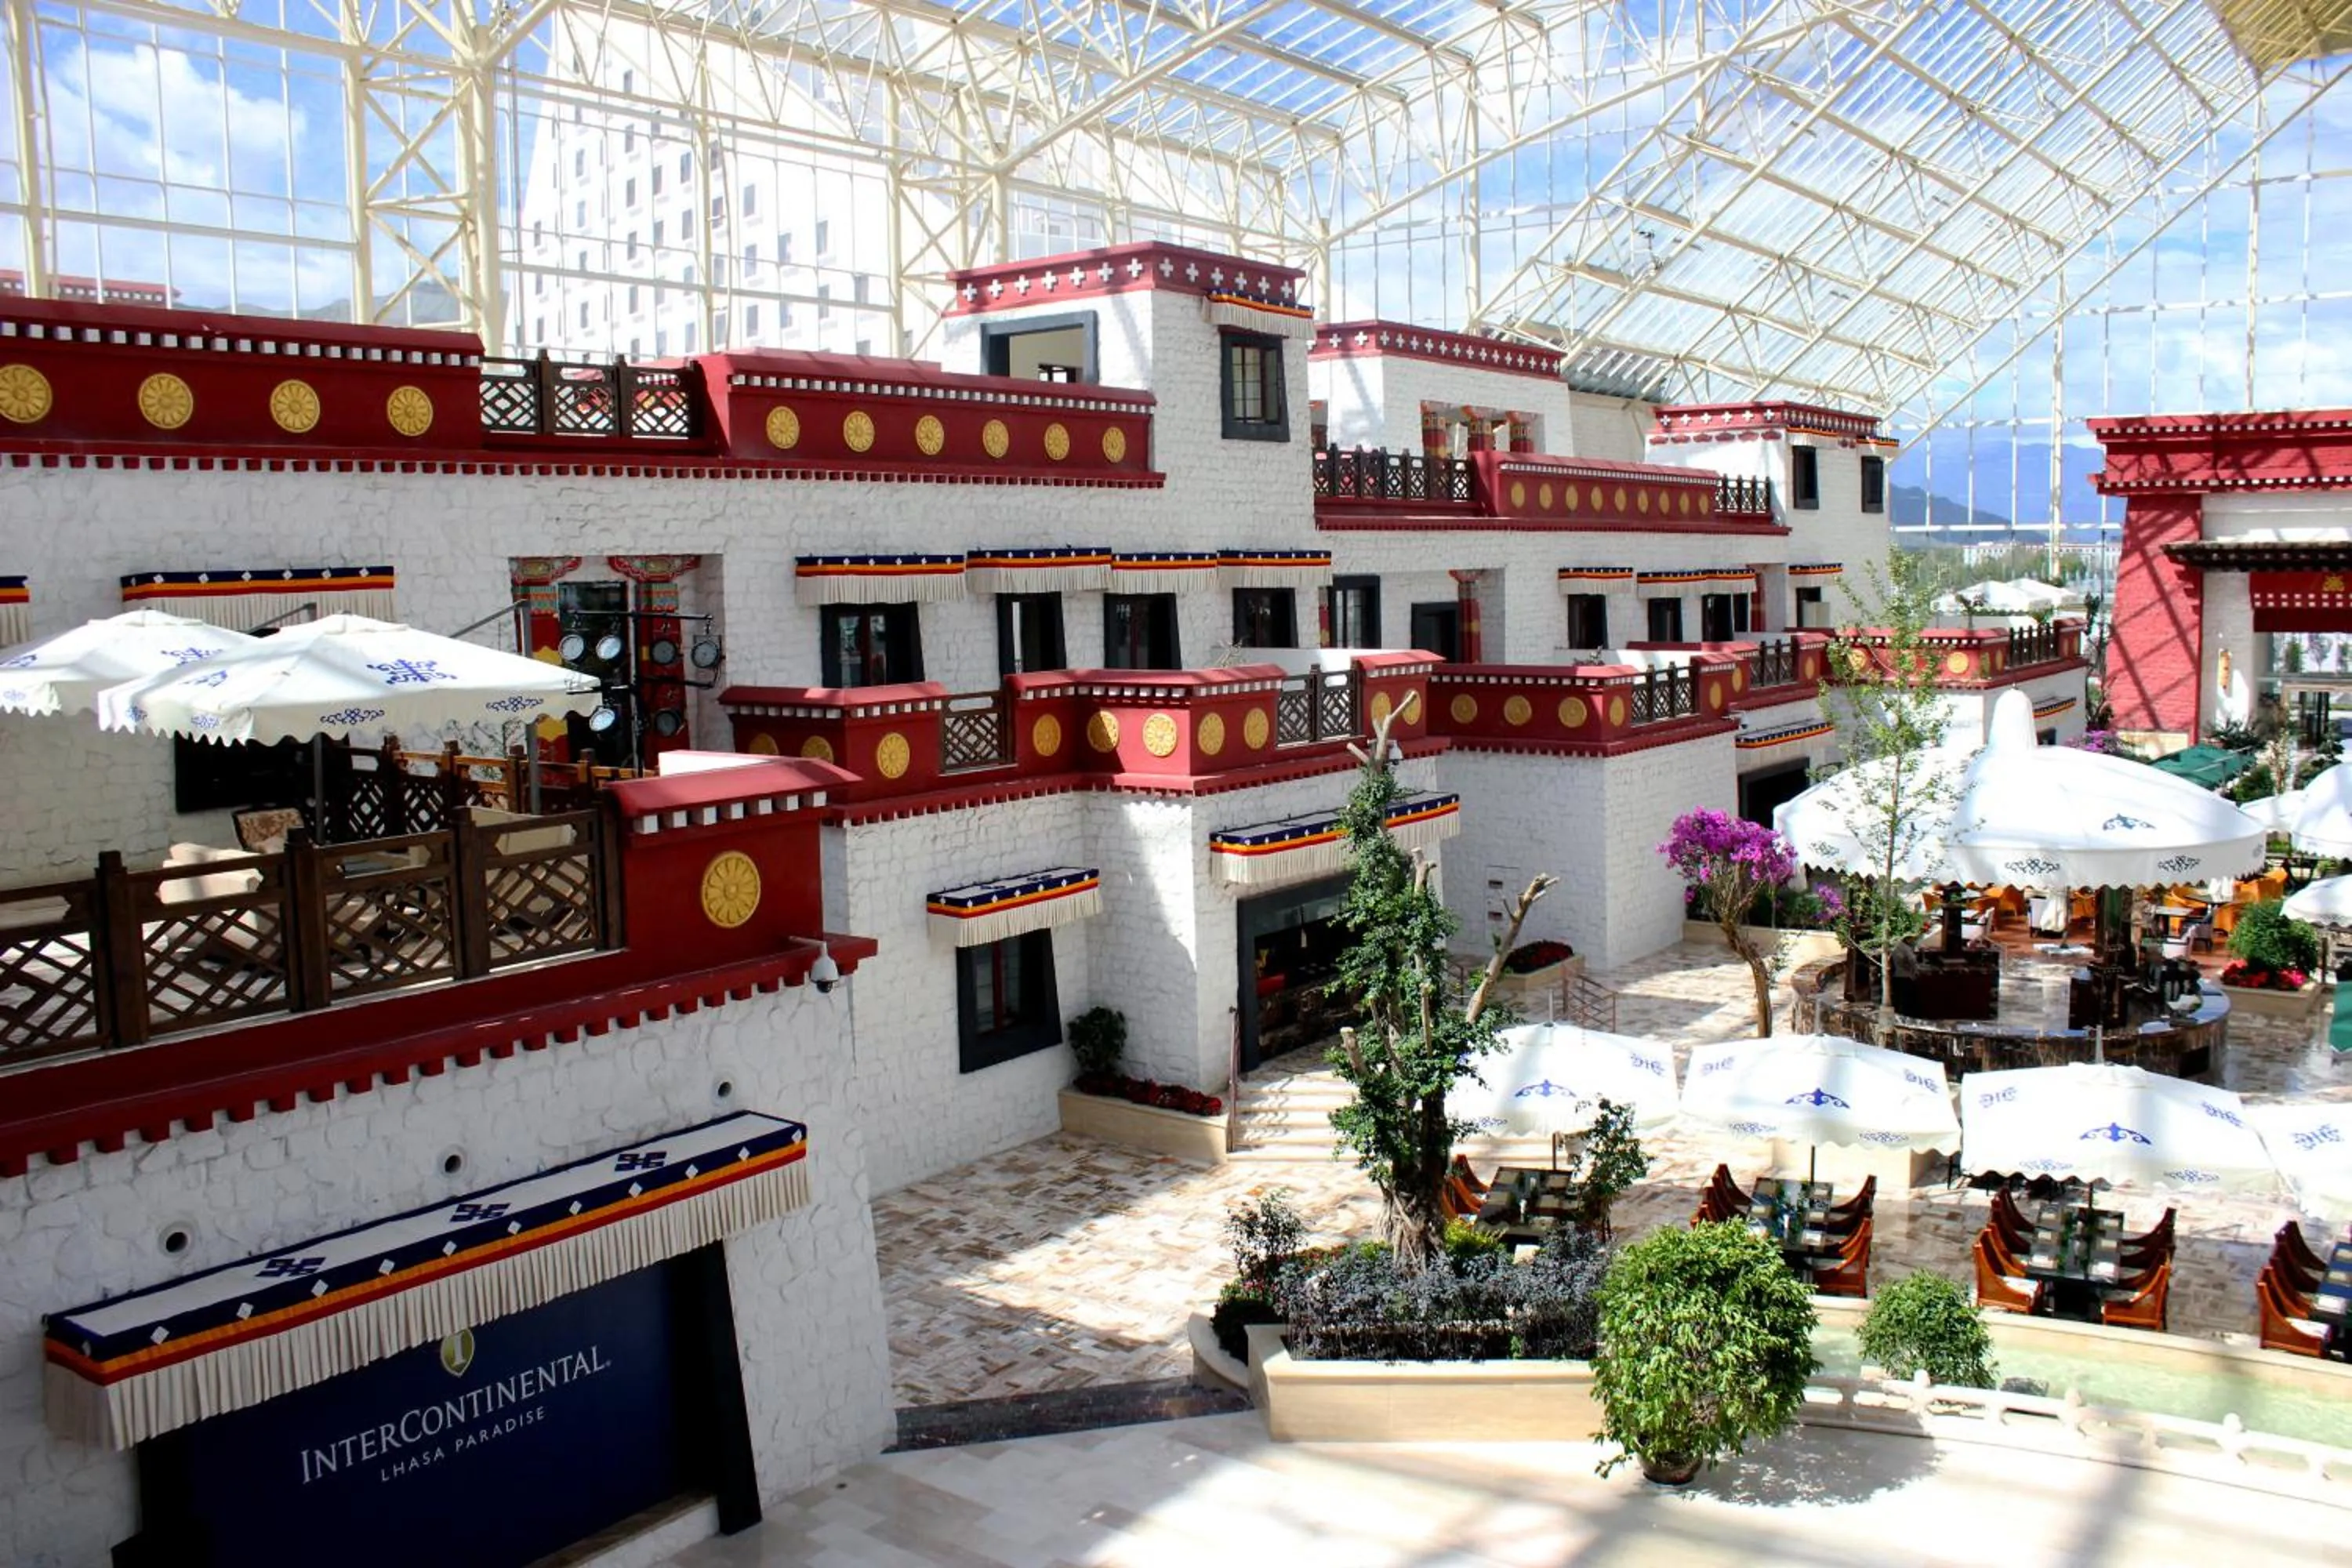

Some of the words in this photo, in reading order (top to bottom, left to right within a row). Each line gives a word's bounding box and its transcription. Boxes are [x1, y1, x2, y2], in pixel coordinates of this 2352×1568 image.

[300, 1345, 606, 1483] INTERCONTINENTAL
[381, 1446, 445, 1482] LHASA
[455, 1406, 546, 1453] PARADISE
